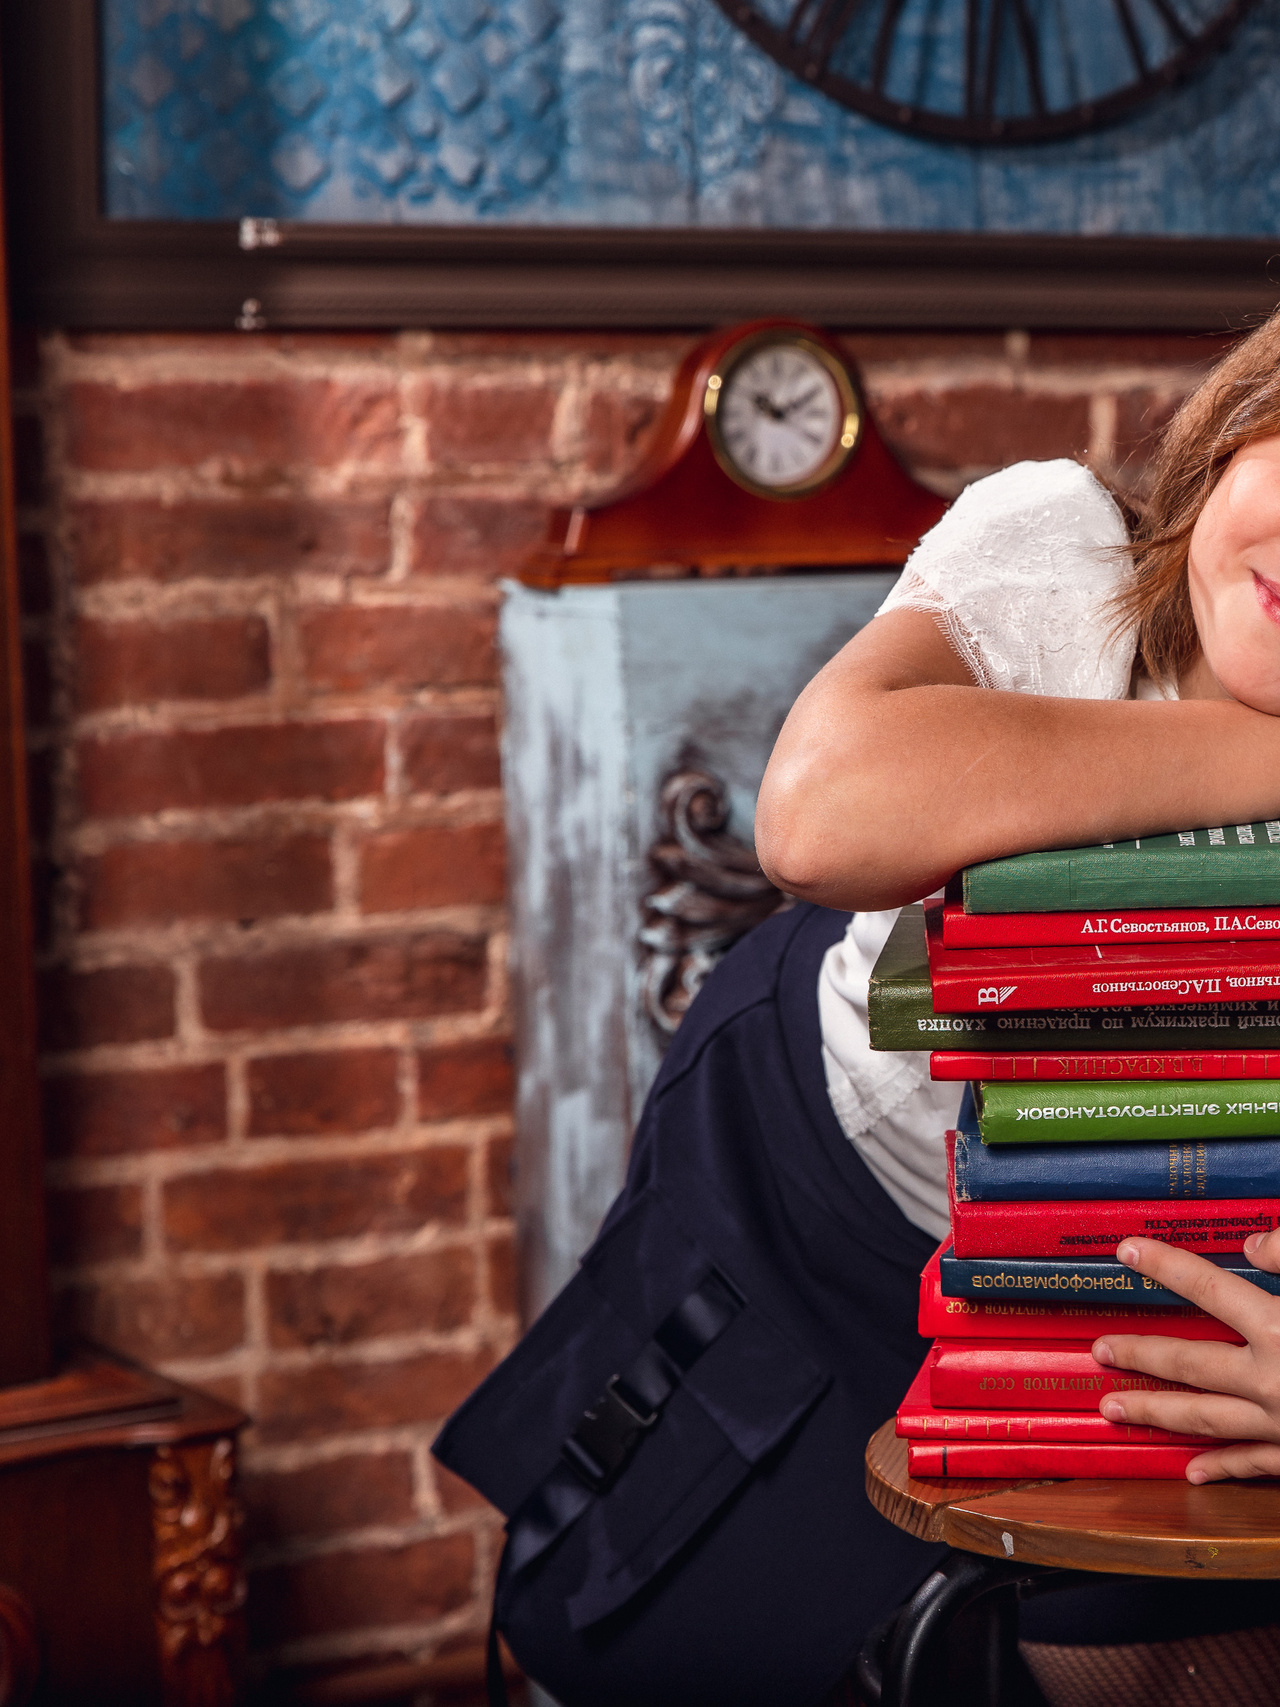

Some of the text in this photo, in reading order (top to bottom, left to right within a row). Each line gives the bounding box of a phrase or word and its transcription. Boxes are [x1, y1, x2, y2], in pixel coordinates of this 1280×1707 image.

[916, 1017, 987, 1032] хлопка
[997, 1013, 1091, 1031] прядению
[1101, 1016, 1124, 1030] по
[1131, 1011, 1230, 1030] практикум
[1015, 1102, 1220, 1121] ЭЛЕКТРОУСТАНОВОК
[1145, 1213, 1272, 1230] промышленности
[971, 1272, 1134, 1293] трансформаторов
[945, 1299, 979, 1314] СССР
[978, 1376, 1016, 1391] СССР
[1023, 1374, 1104, 1391] ДЕПУТАТОВ
